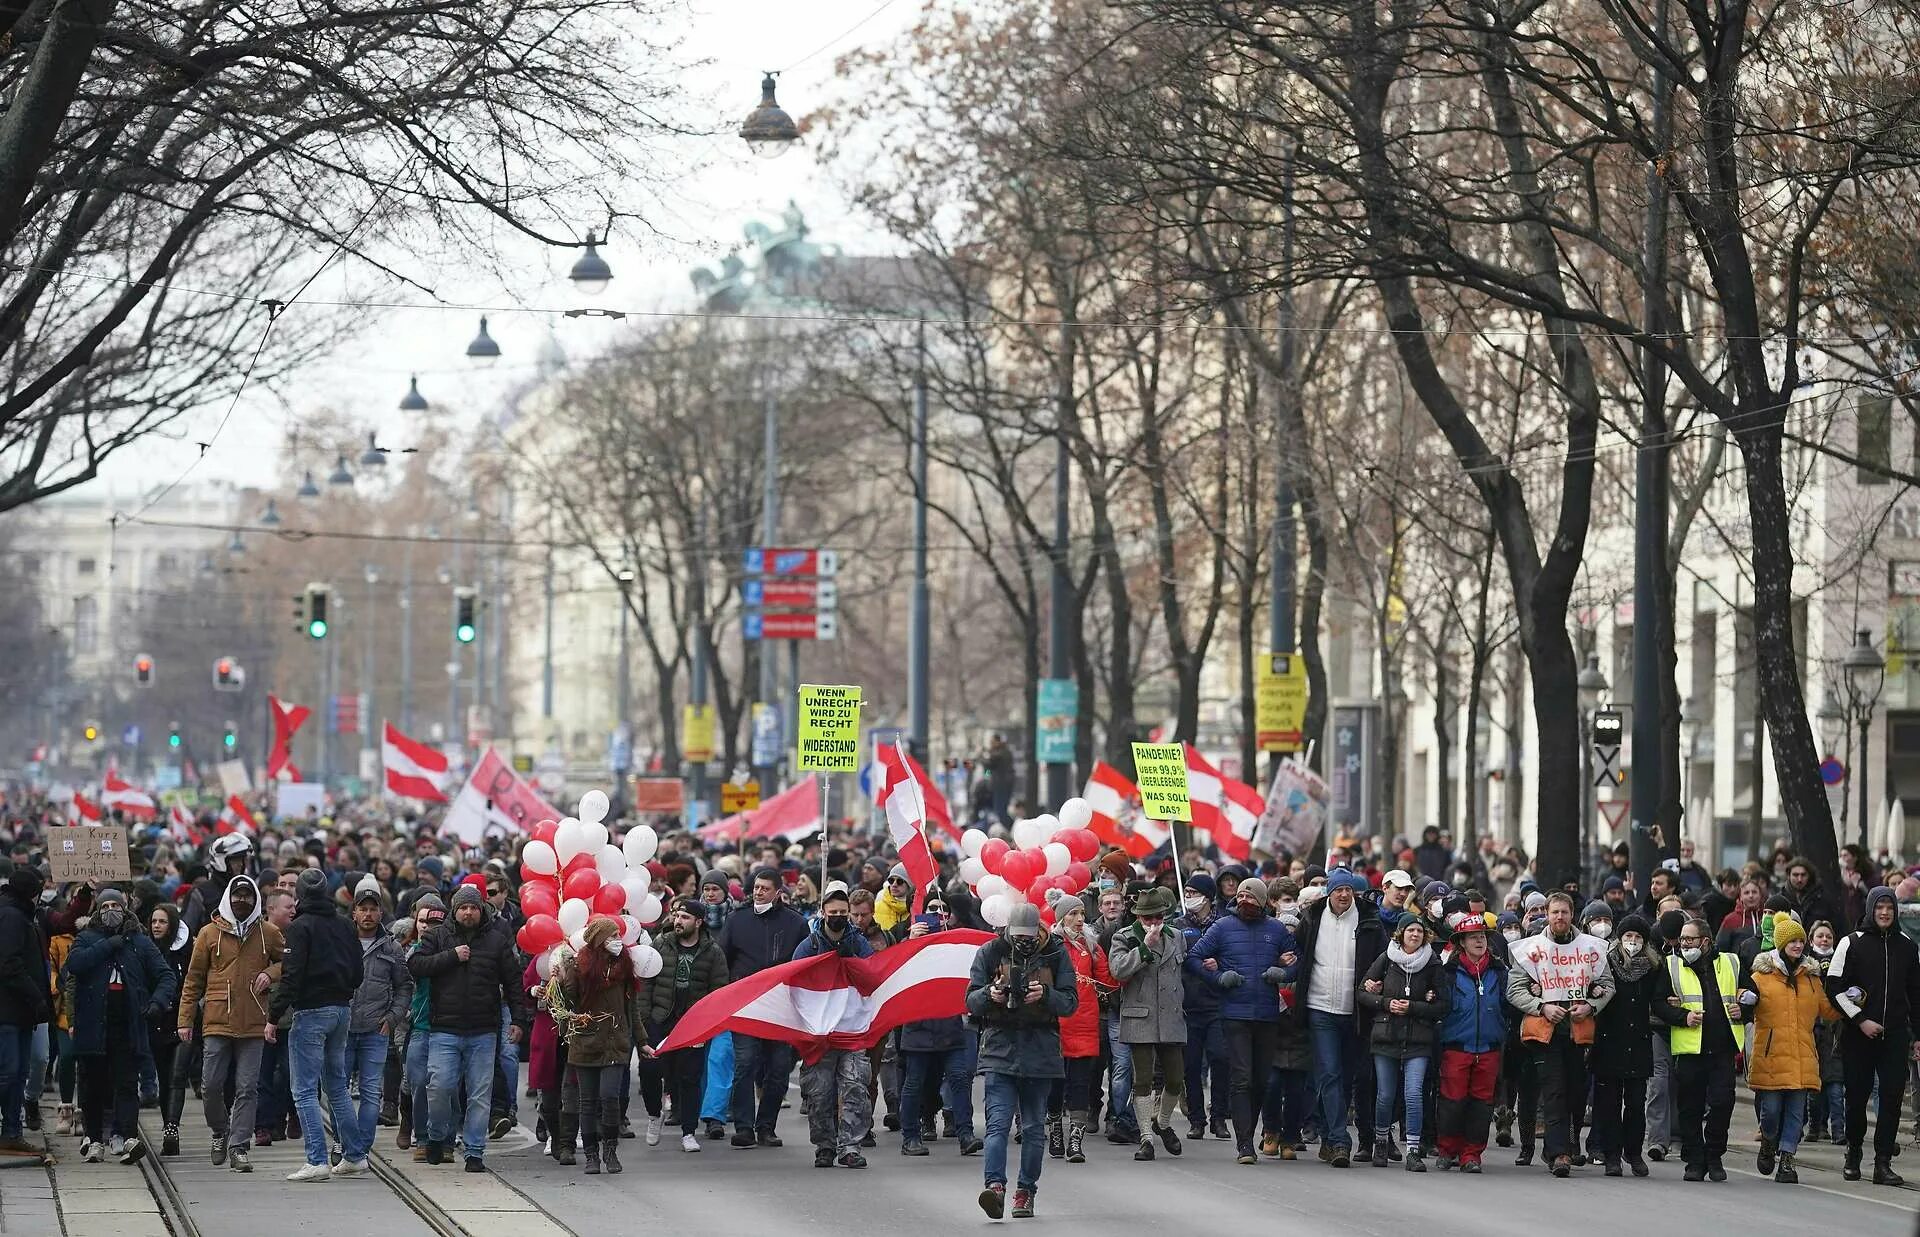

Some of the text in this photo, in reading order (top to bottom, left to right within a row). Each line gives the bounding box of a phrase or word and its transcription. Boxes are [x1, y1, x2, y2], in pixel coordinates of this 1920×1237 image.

[817, 689, 846, 697] WENN
[806, 698, 859, 708] UNRECHT
[810, 709, 835, 717] WIRD
[810, 719, 853, 728] RECHT
[804, 739, 856, 753] WIDERSTAND
[1136, 748, 1181, 760] PANDEMIE?
[803, 755, 854, 767] PFLICHT!!
[1159, 765, 1185, 776] 99,9%
[1145, 792, 1189, 802] WAS SOLL
[1160, 806, 1181, 814] DAS?
[89, 828, 118, 840] Kurz
[86, 848, 118, 860] Soros
